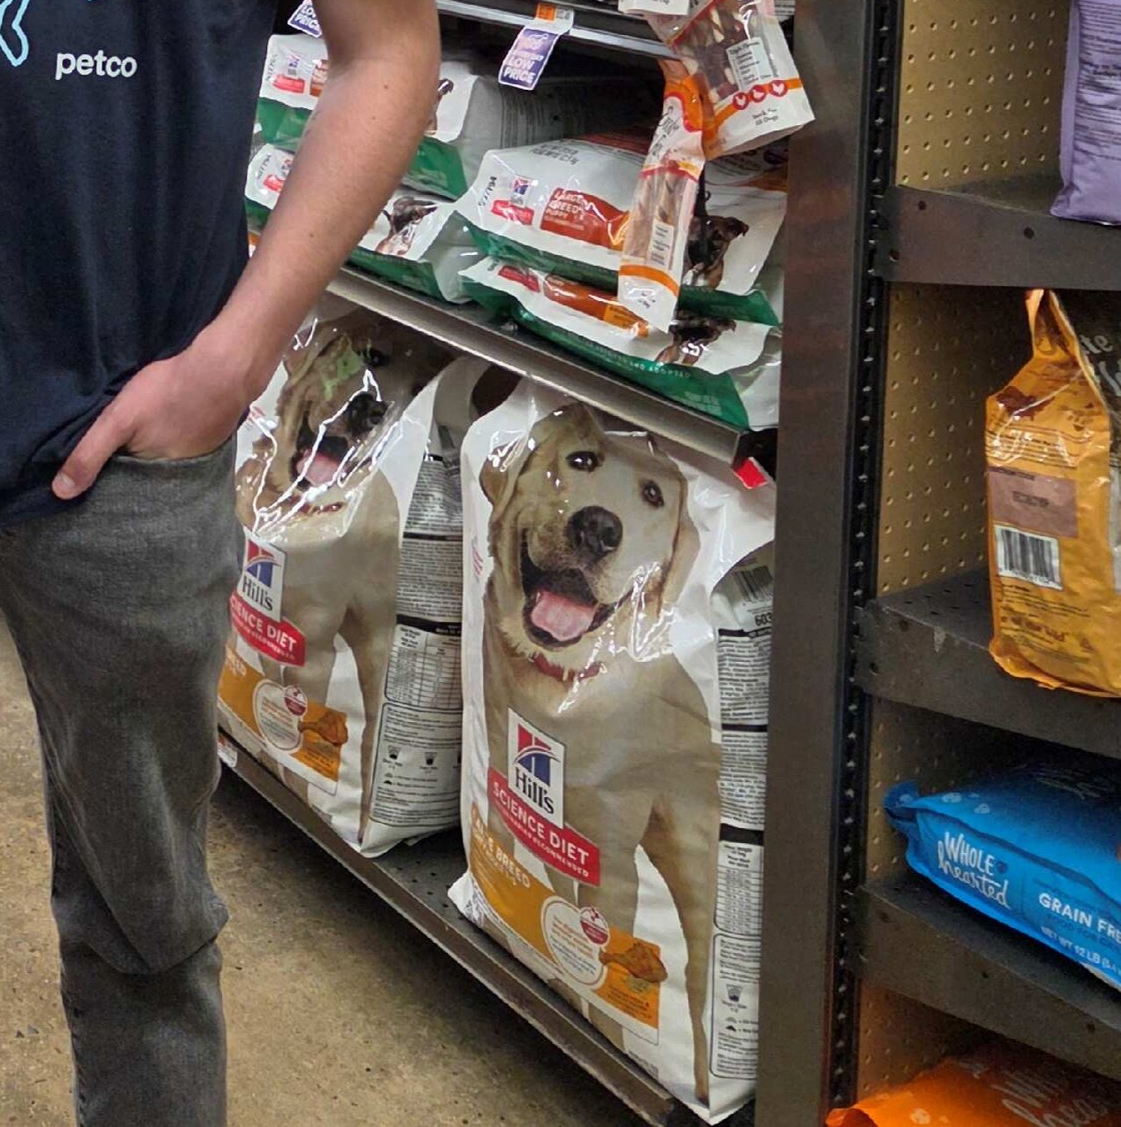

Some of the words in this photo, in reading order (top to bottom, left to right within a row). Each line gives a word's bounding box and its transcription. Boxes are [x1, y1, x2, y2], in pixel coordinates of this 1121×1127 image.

[55, 50, 138, 80] petco
[503, 66, 536, 84] PRICE
[508, 56, 535, 70] LOW
[242, 575, 273, 612] Hill's
[230, 595, 264, 633] CIENCE
[267, 626, 298, 652] DIET
[515, 767, 554, 815] Hill's
[493, 781, 545, 839] SCIENCE
[550, 832, 589, 865] DIET
[496, 847, 531, 888] BREED
[944, 831, 995, 876] WHOLE
[938, 840, 1011, 910] hearted
[1038, 892, 1093, 928] GRAIN
[1087, 951, 1101, 965] LB
